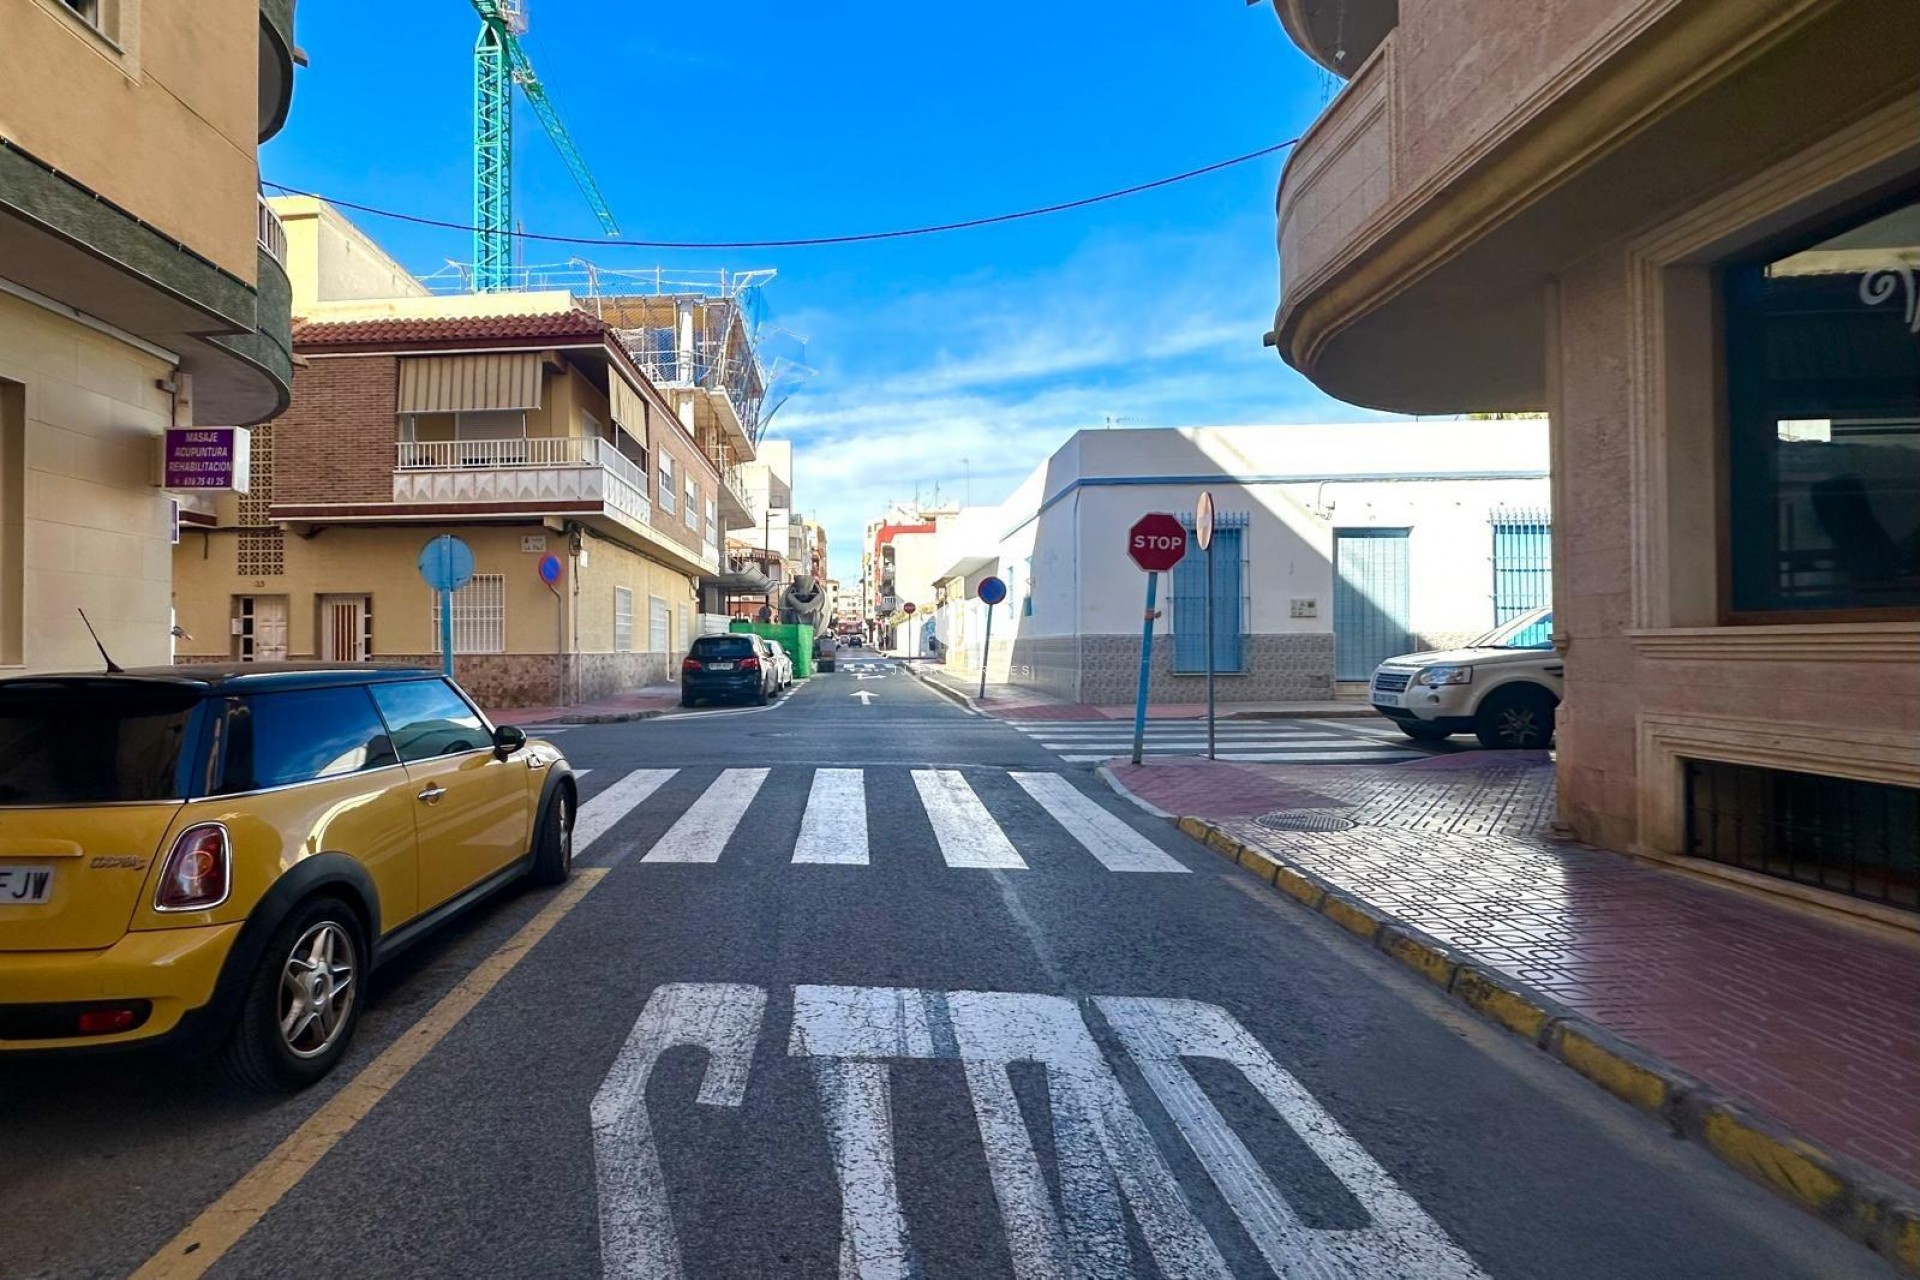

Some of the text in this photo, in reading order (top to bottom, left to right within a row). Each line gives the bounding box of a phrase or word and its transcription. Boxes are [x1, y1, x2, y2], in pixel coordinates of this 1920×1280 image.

[185, 432, 218, 442] MASAJE
[174, 447, 228, 457] ACUPUNTURA
[1134, 535, 1182, 550] STOP
[590, 982, 1495, 1280] STOP
